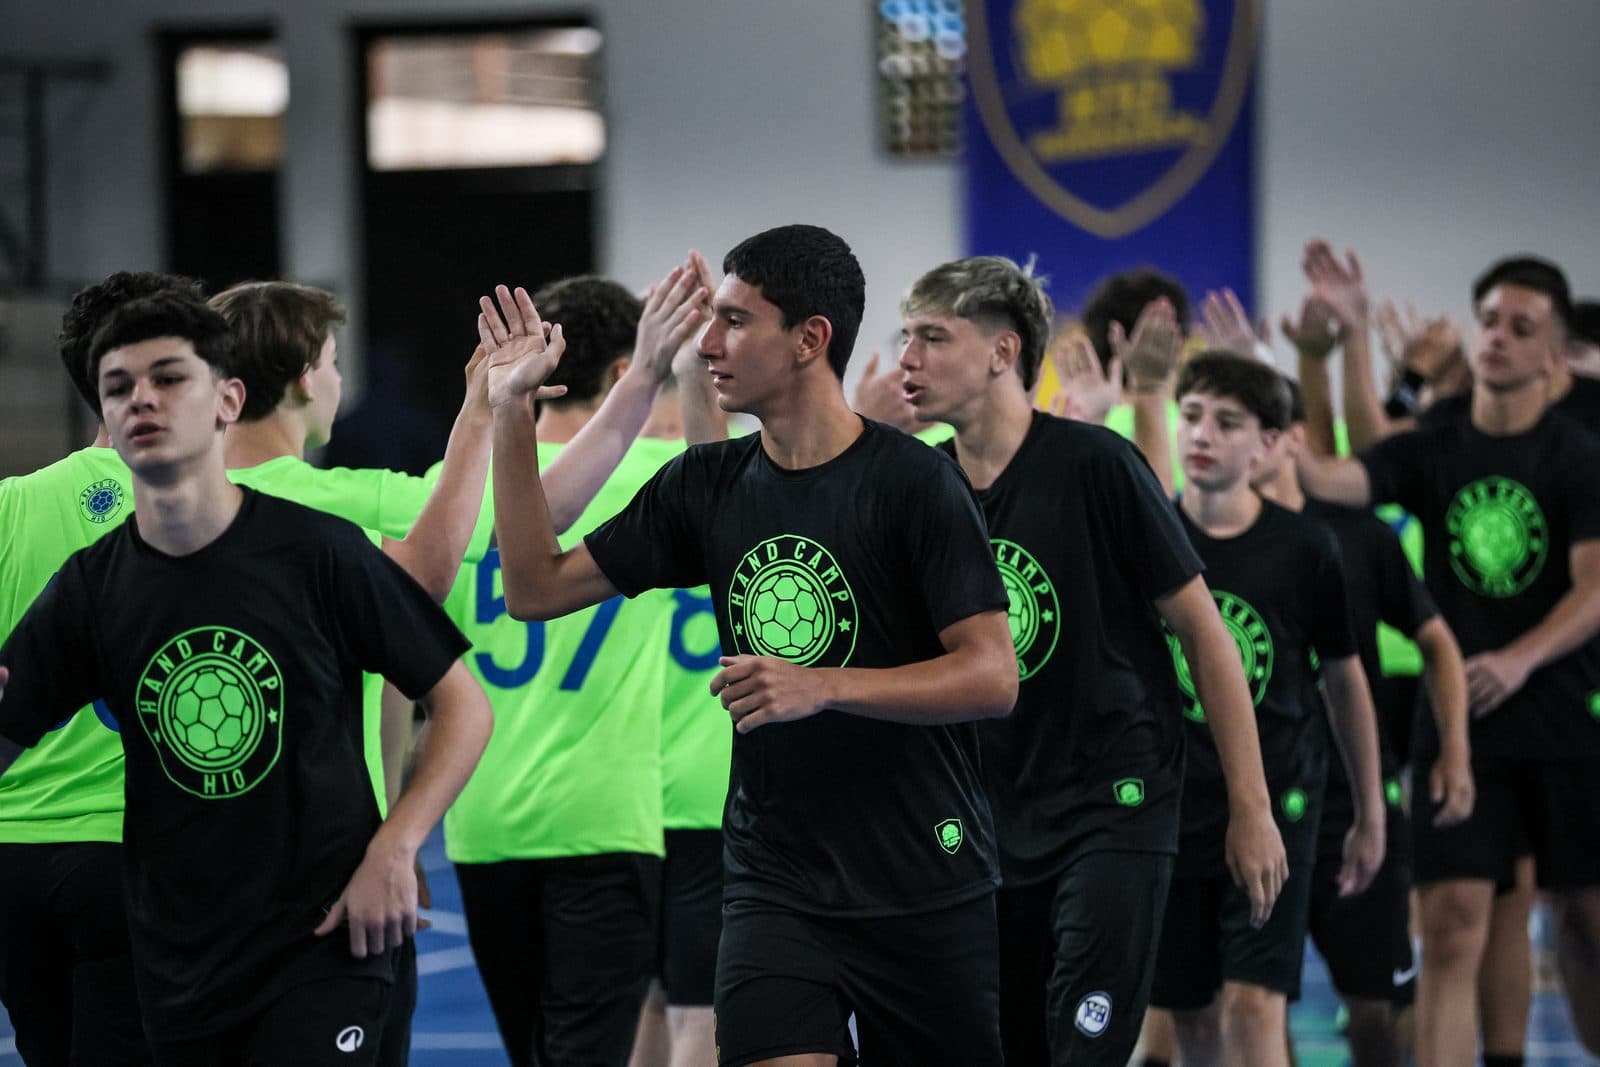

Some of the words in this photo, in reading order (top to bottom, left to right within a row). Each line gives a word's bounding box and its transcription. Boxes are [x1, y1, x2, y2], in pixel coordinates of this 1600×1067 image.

[731, 542, 778, 607] HAND
[794, 541, 850, 602] CAMP
[996, 543, 1050, 595] CAMP
[139, 638, 193, 714] HAND
[212, 631, 279, 690] CAMP
